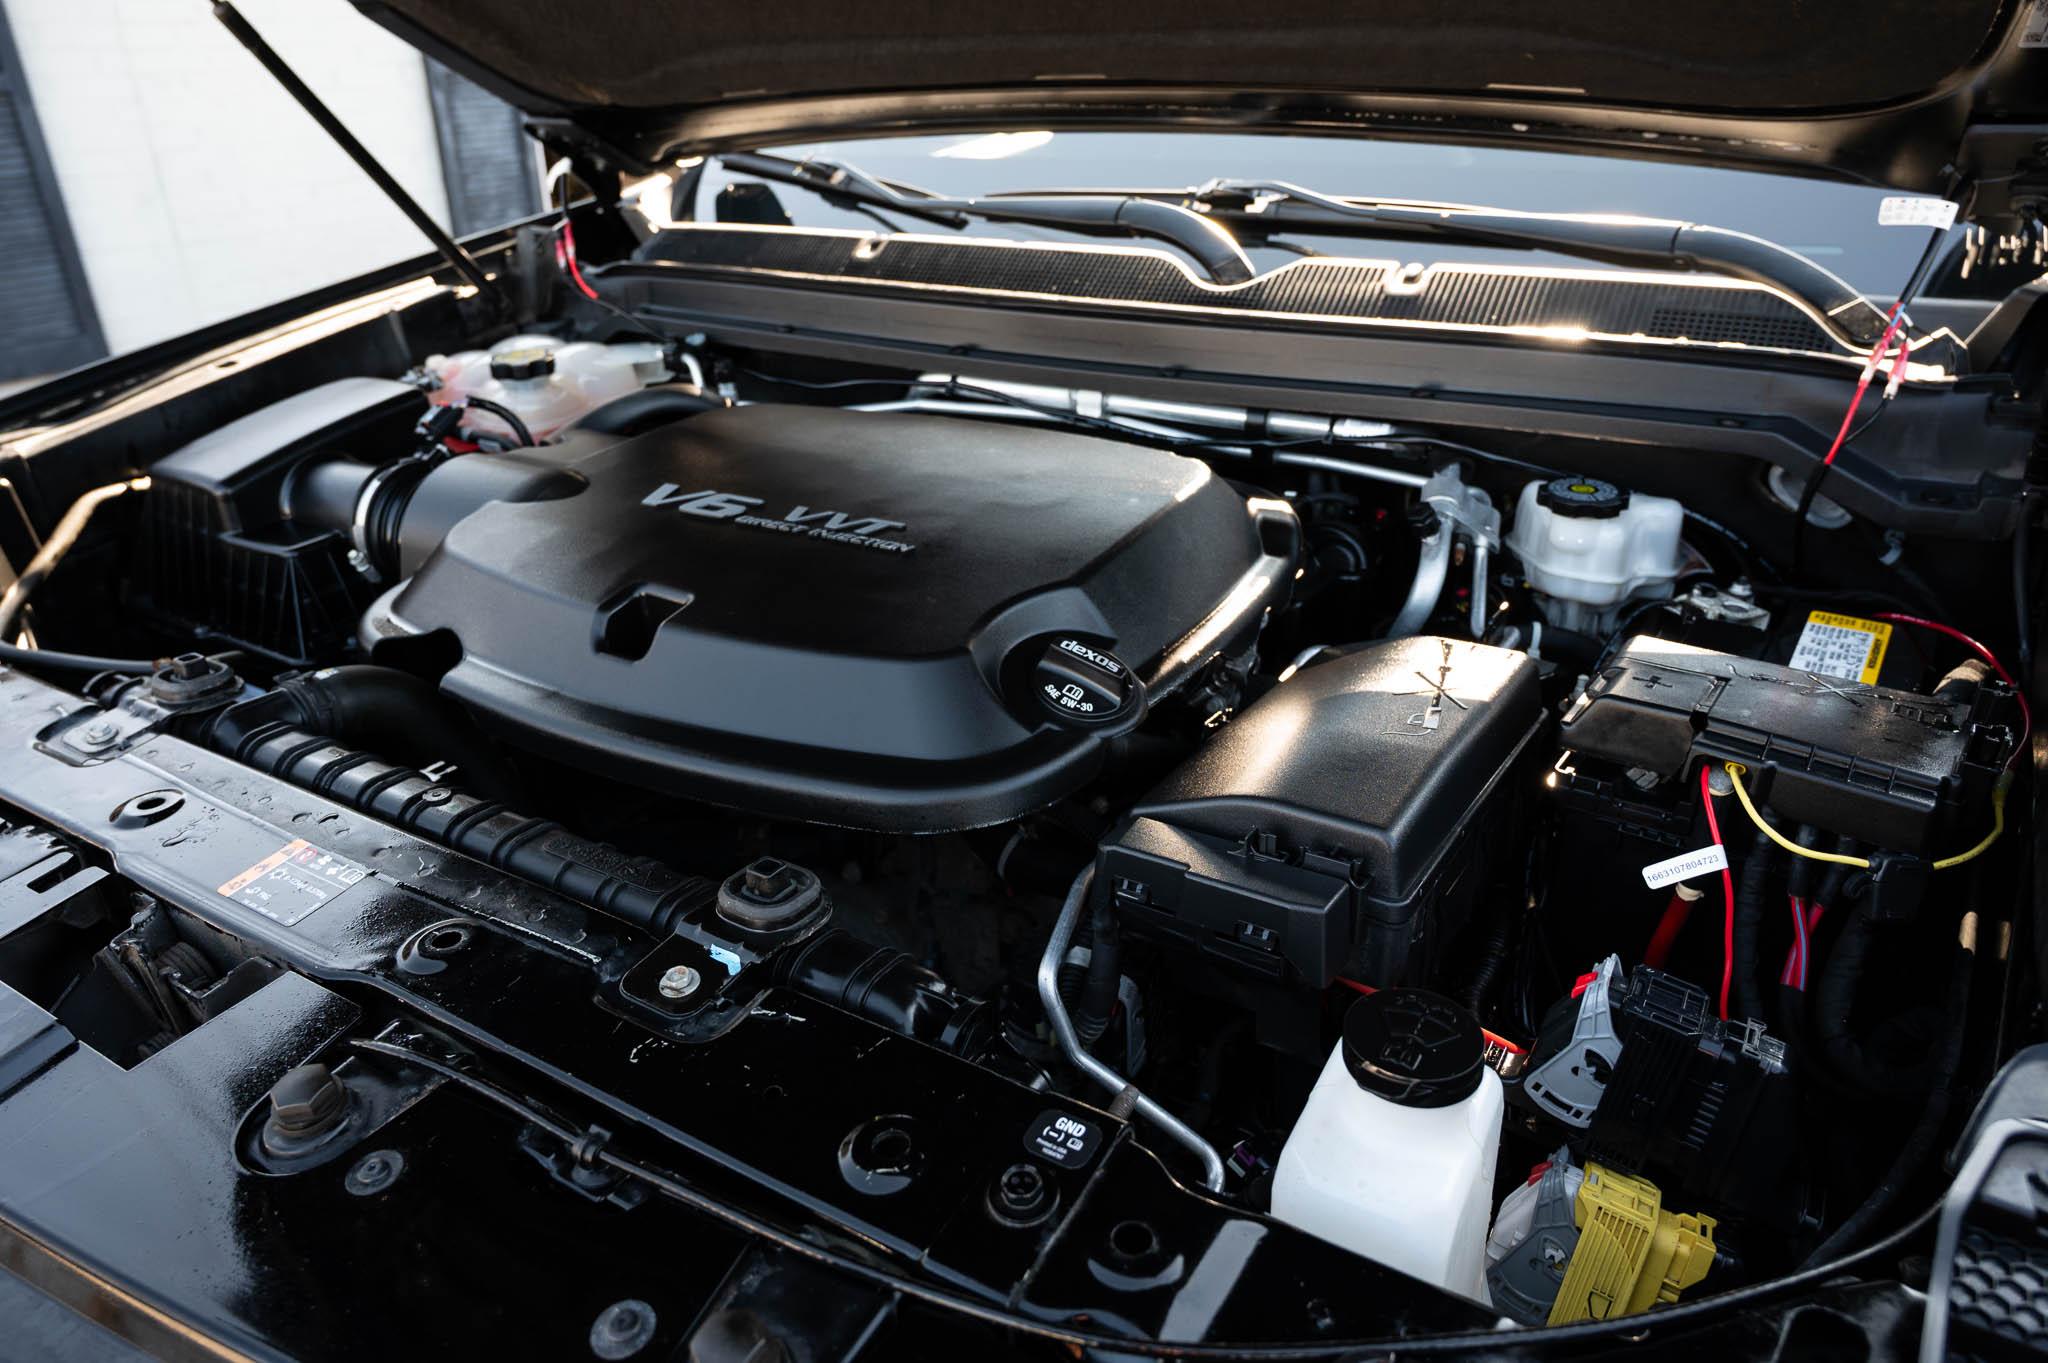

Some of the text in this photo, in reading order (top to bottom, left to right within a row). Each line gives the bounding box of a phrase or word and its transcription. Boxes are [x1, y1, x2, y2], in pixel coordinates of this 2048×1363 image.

[640, 482, 906, 535] V6 VVT
[734, 515, 916, 552] DIRECT INJECTION
[1060, 640, 1121, 673] dexos
[1044, 684, 1094, 712] SAE 5W-30
[1647, 854, 1719, 882] 1663107804723
[1055, 1116, 1086, 1138] GND
